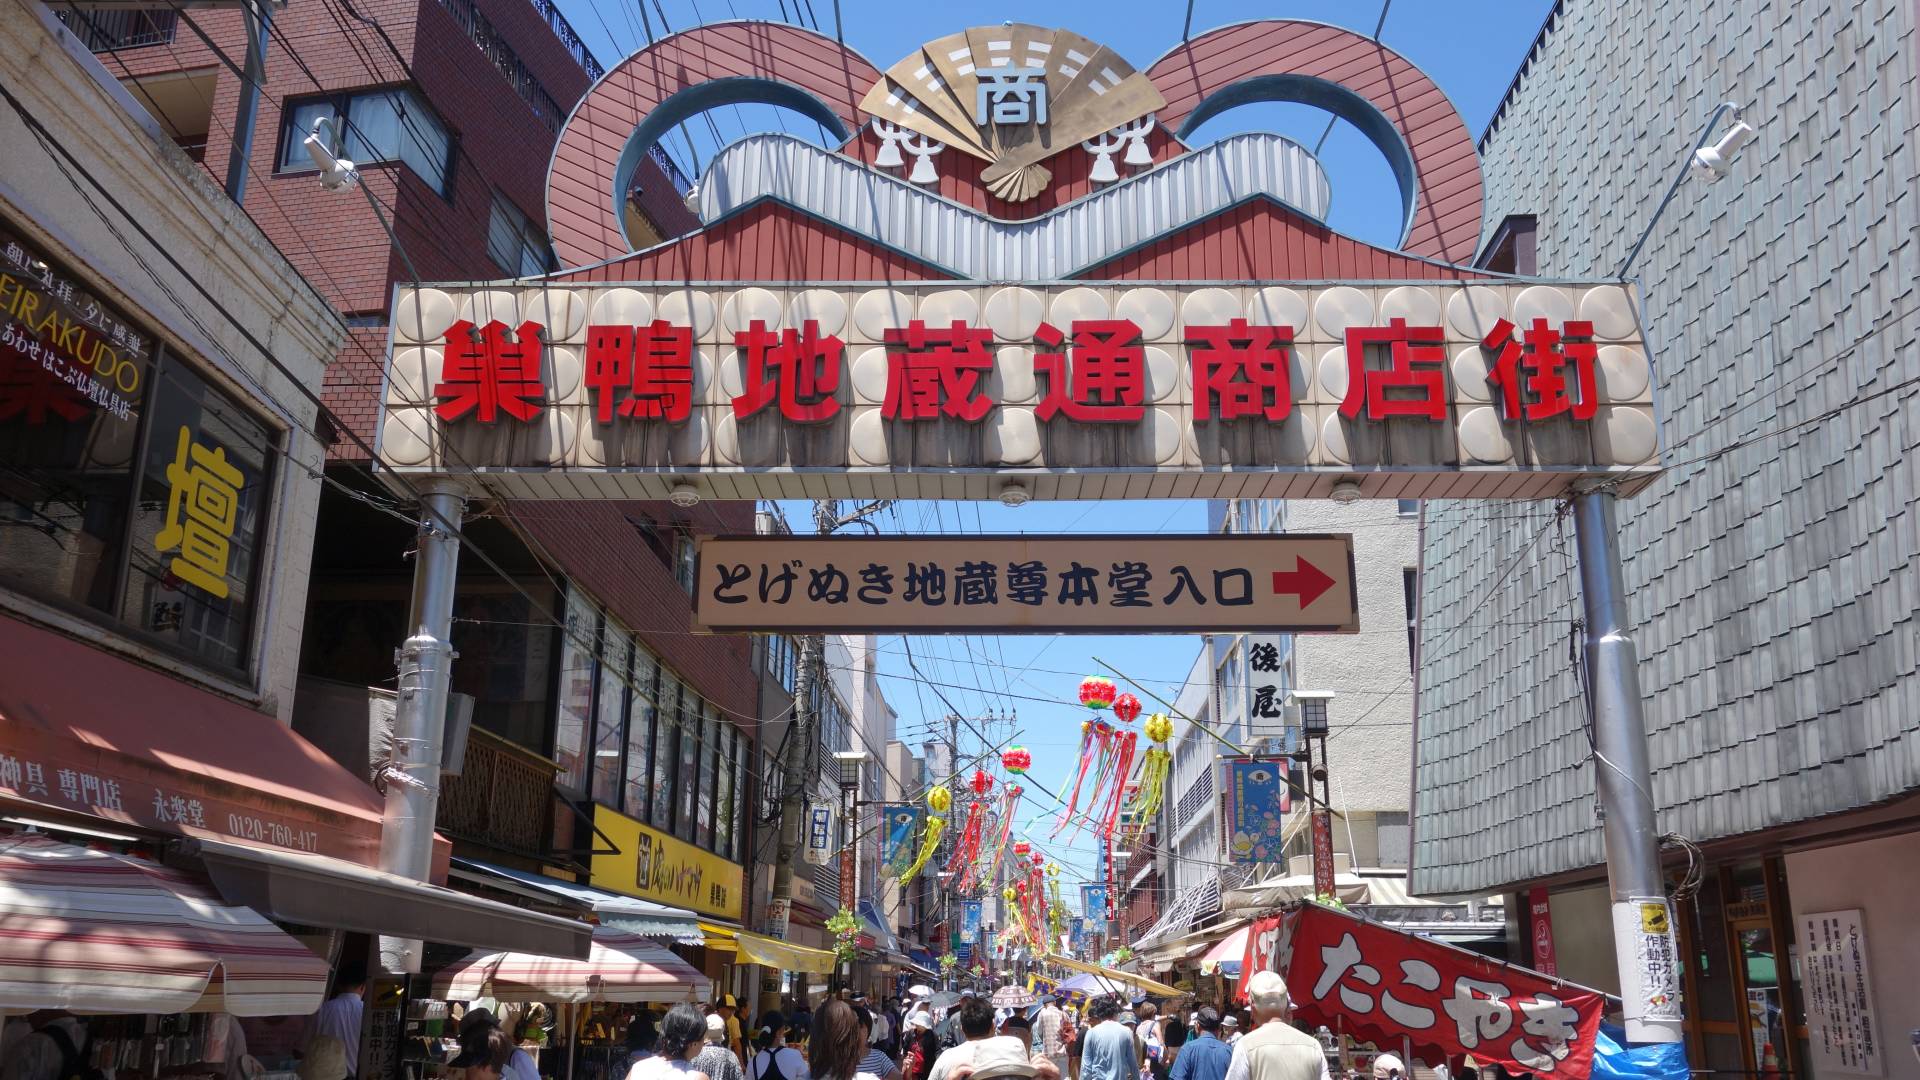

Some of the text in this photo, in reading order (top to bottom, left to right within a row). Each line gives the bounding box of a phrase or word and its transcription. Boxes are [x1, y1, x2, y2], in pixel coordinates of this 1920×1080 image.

[976, 60, 1047, 126] 商
[434, 318, 1597, 424] 巣鴨地蔵通商店街
[155, 425, 245, 599] 壇
[712, 559, 1255, 607] とげぬき地蔵尊本堂入口
[57, 768, 122, 812] 専門店
[153, 788, 206, 829] 永楽堂
[229, 812, 318, 852] 0120-760-417
[1312, 932, 1580, 1072] たこやき
[1659, 934, 1675, 1001] 防犯カメラ
